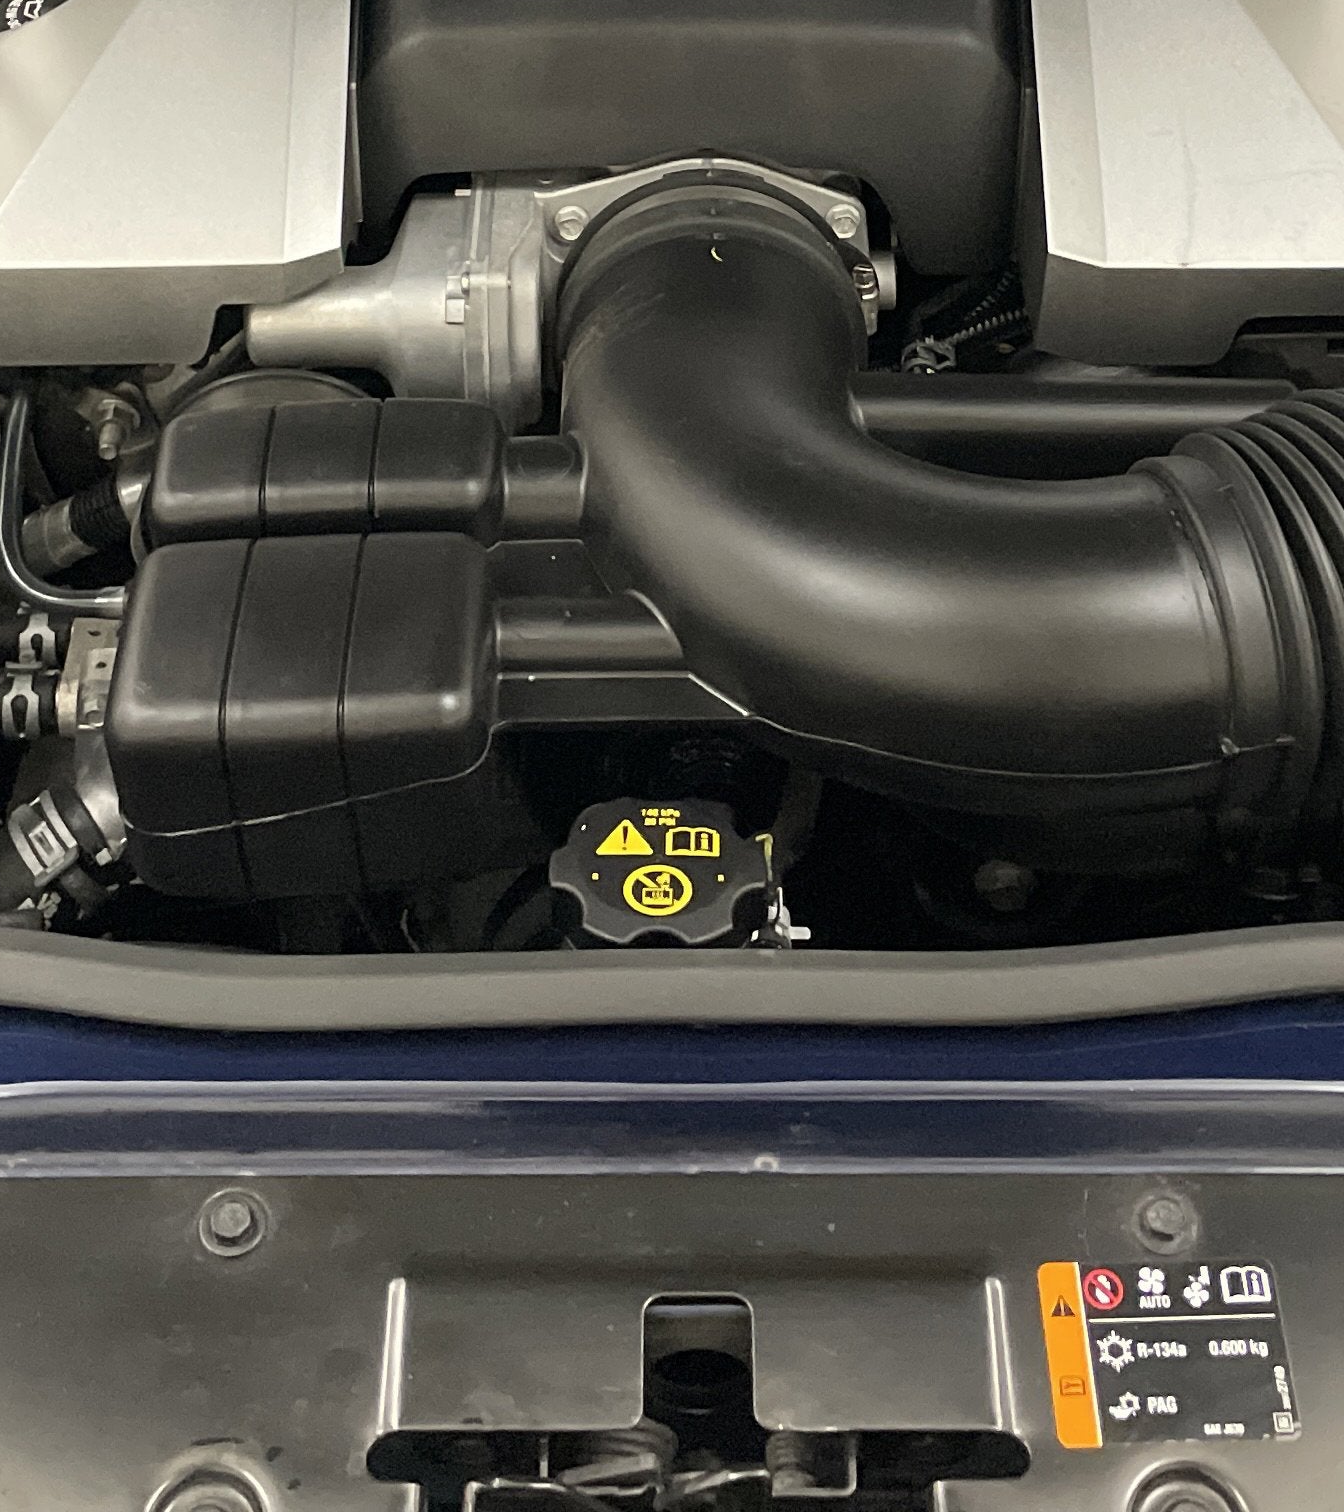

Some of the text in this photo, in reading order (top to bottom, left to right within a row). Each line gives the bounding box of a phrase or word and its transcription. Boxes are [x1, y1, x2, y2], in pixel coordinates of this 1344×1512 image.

[1139, 1294, 1171, 1309] AUTO
[1136, 1341, 1187, 1358] R-134a
[1249, 1338, 1269, 1358] kg
[1147, 1395, 1178, 1414] PAG
